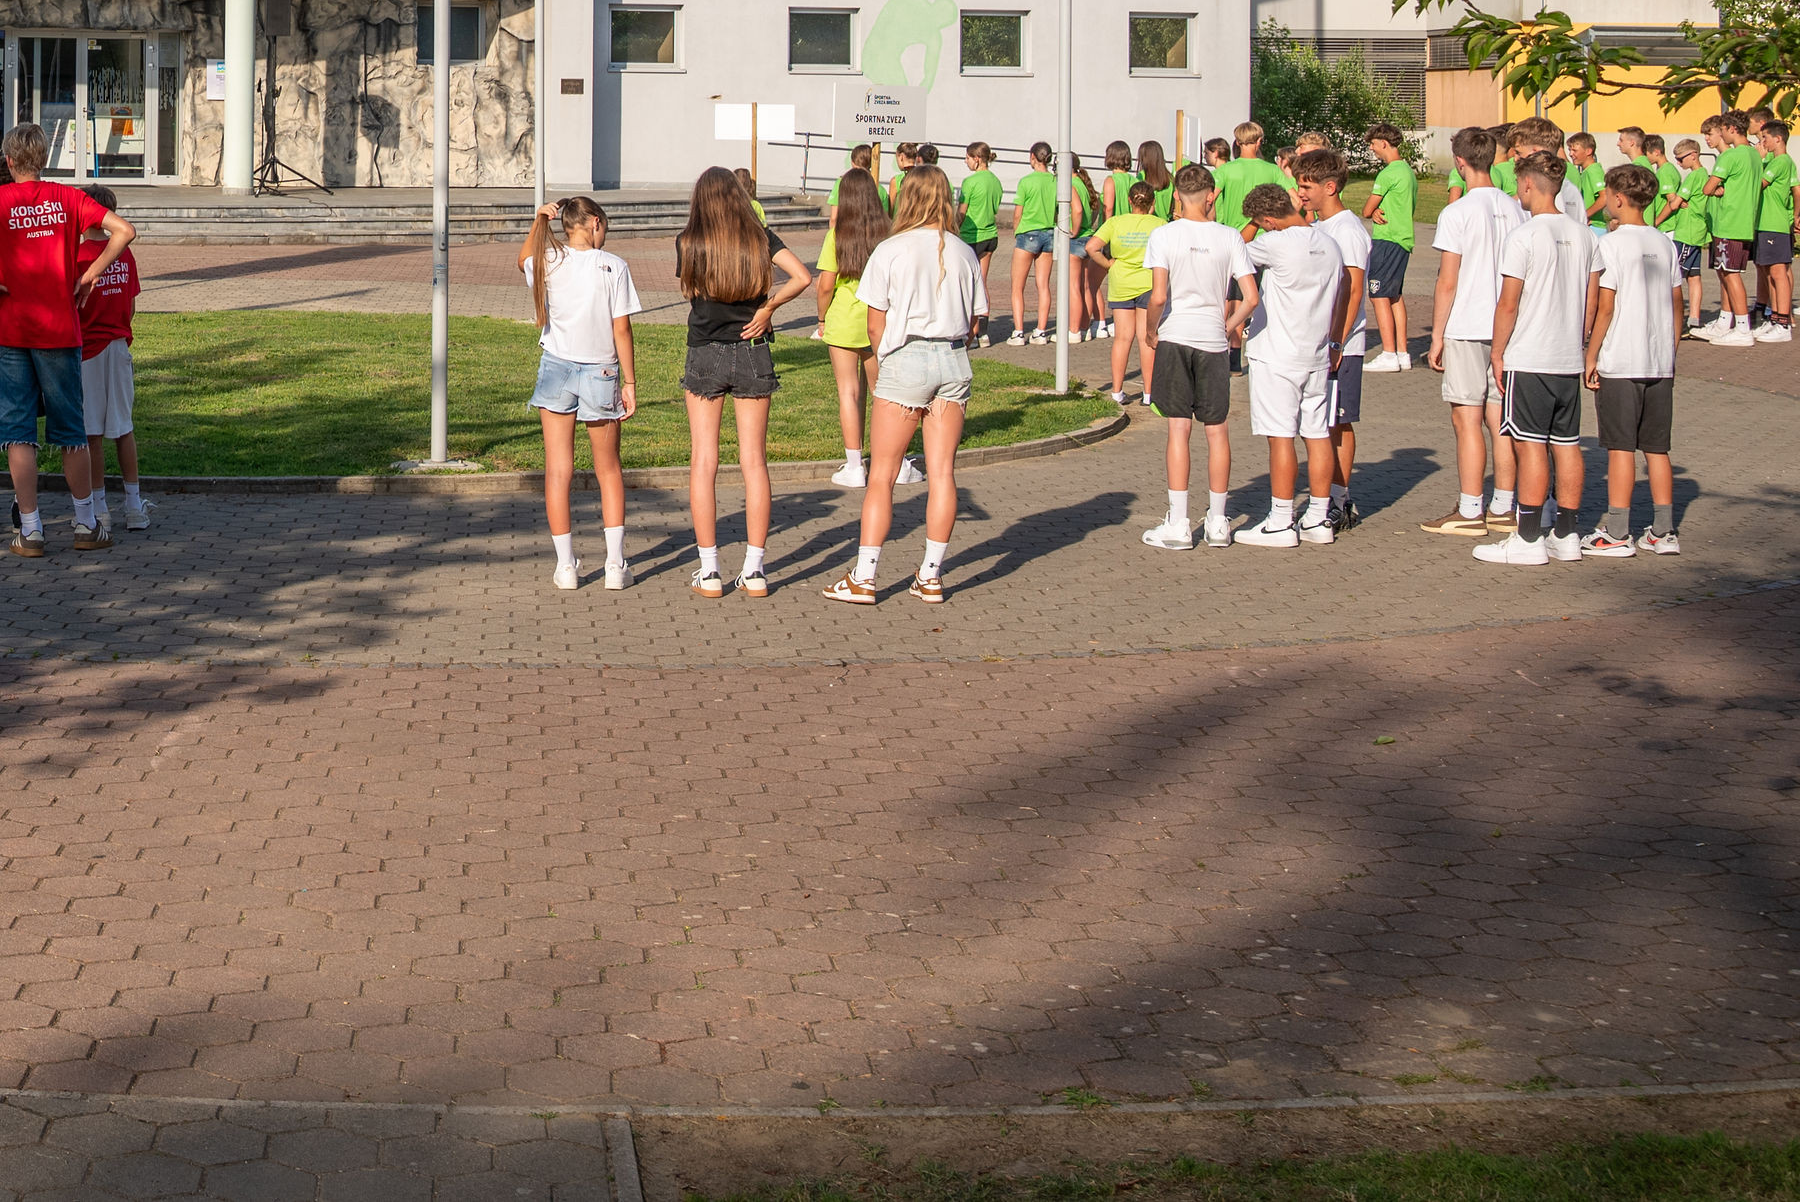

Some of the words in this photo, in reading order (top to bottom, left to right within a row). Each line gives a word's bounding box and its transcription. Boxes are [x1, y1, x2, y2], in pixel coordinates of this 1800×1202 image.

[855, 113, 885, 124] ŠPORTNA
[886, 115, 906, 124] ZVEZA
[868, 126, 894, 136] BREŽICE
[10, 200, 63, 218] KOROŠKI
[8, 212, 67, 229] SLOVENCI
[26, 230, 54, 238] AUSTRIA
